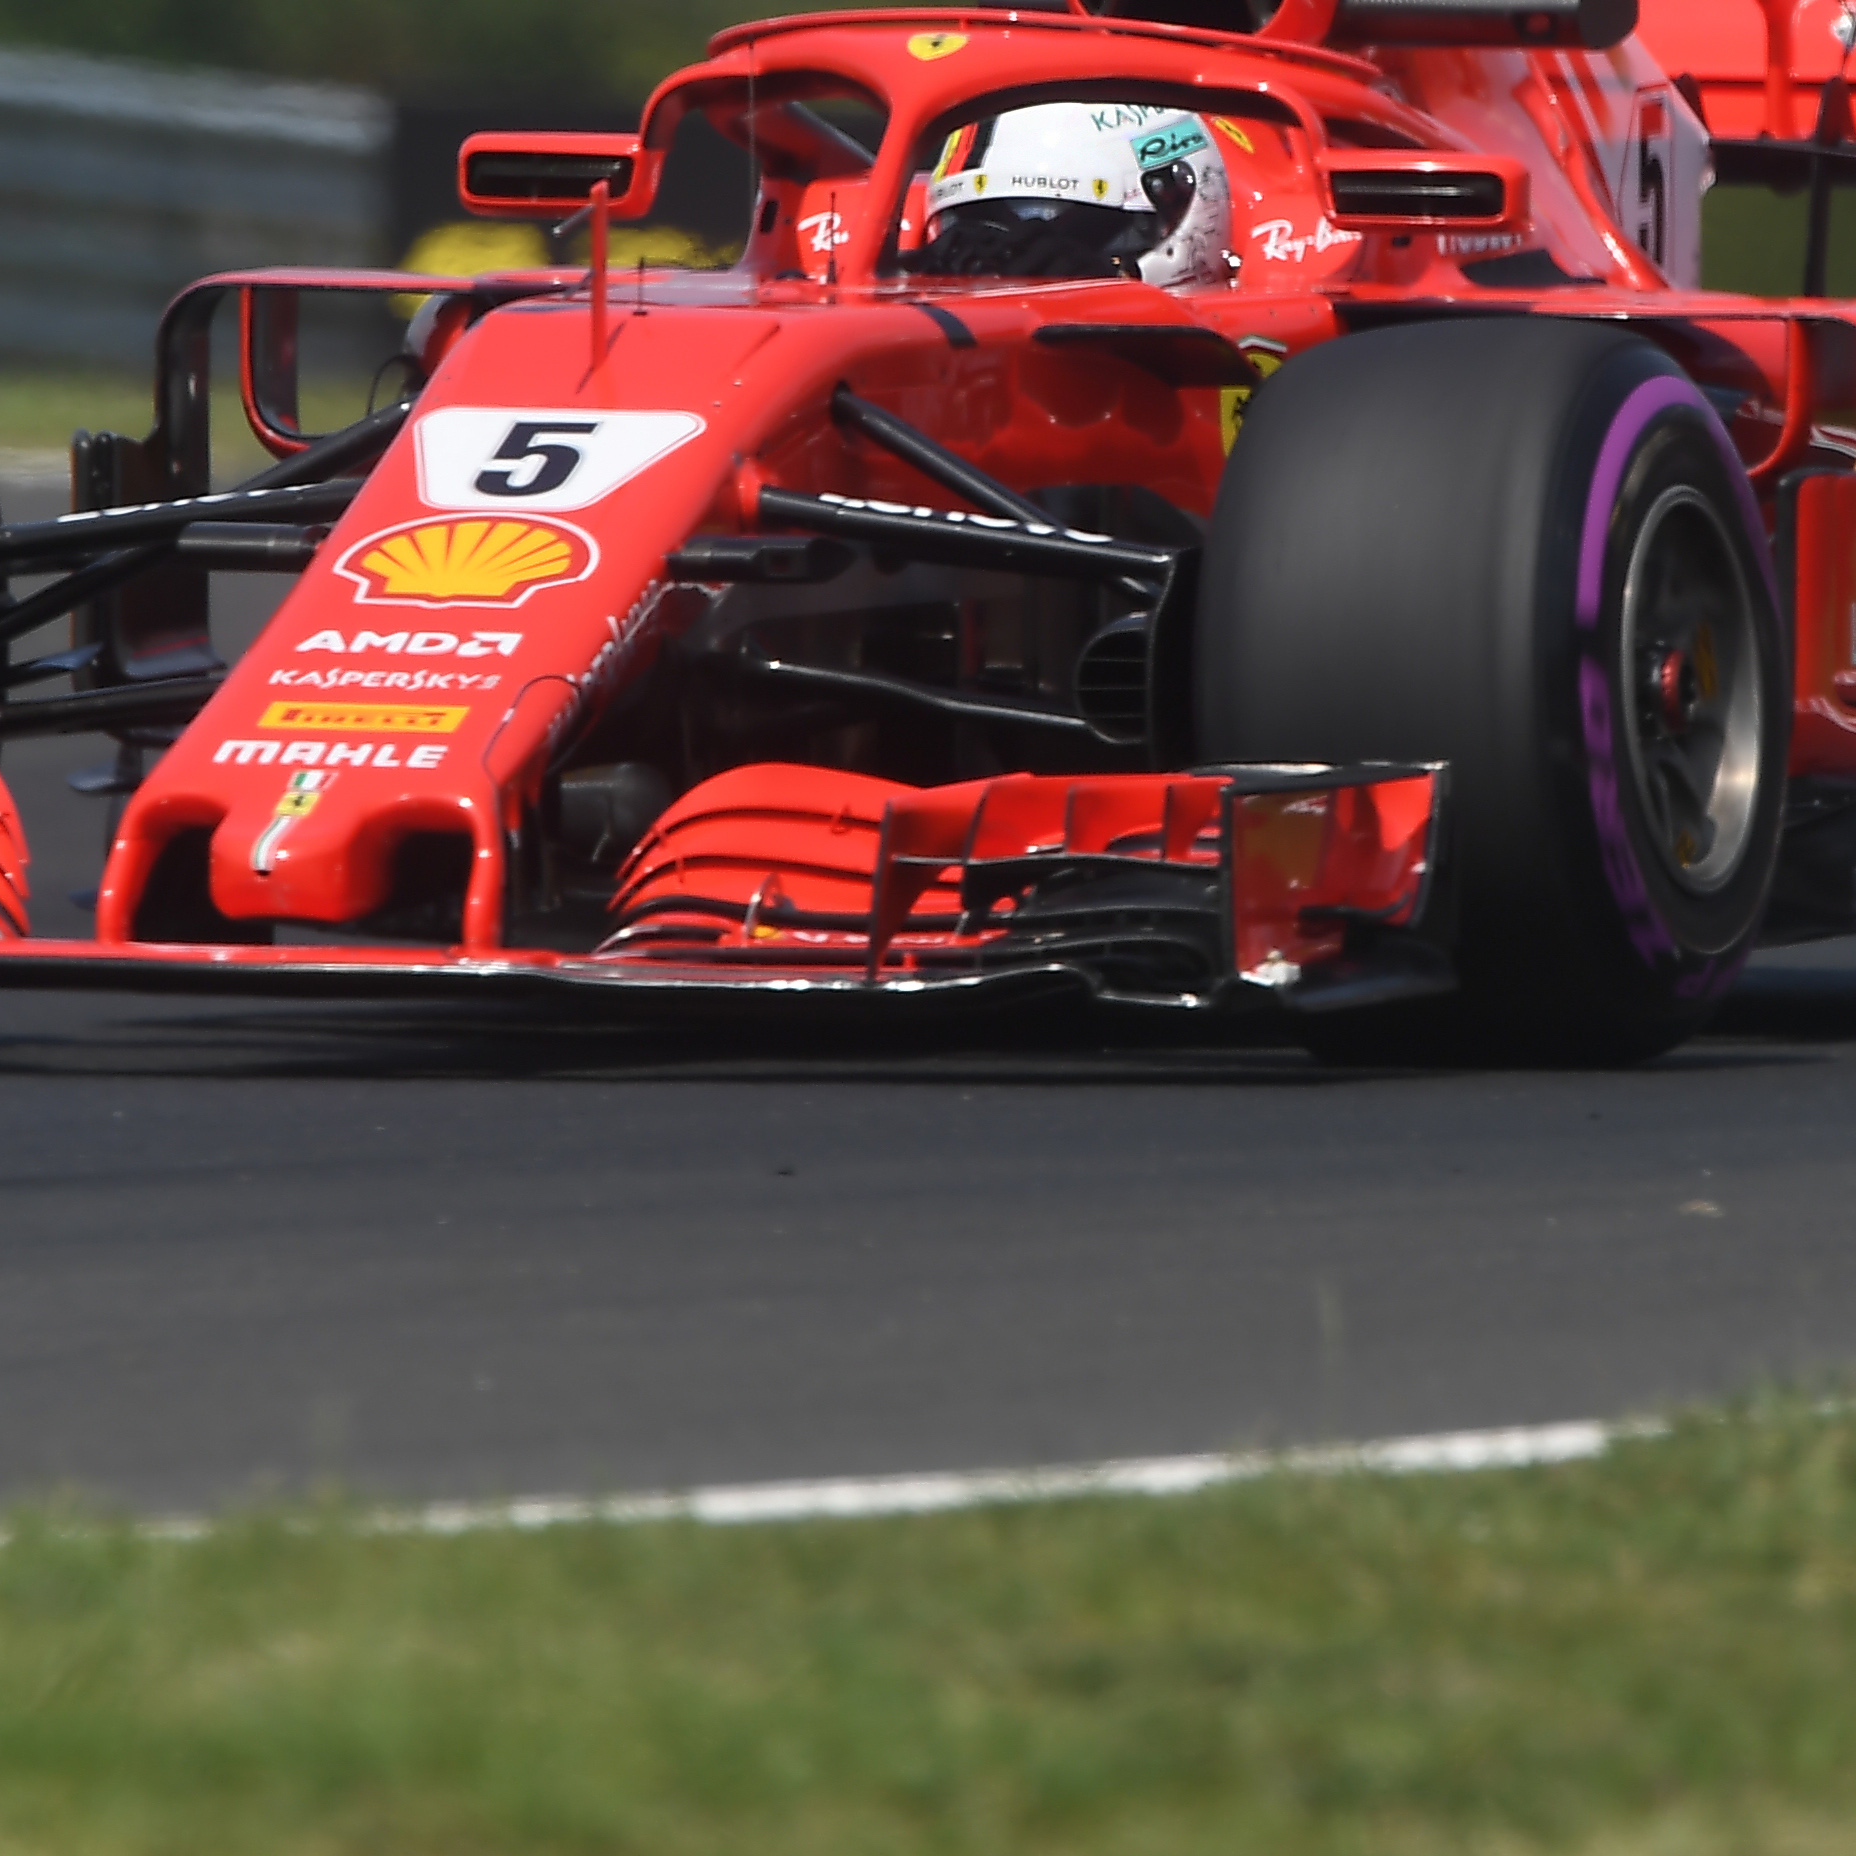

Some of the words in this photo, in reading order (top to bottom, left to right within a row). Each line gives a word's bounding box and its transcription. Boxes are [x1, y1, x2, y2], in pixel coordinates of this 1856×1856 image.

[1011, 176, 1080, 191] HUBLOT
[474, 421, 599, 497] 5
[295, 629, 460, 655] AMD
[267, 667, 483, 690] KASPERSKY
[211, 739, 449, 769] MAHLE
